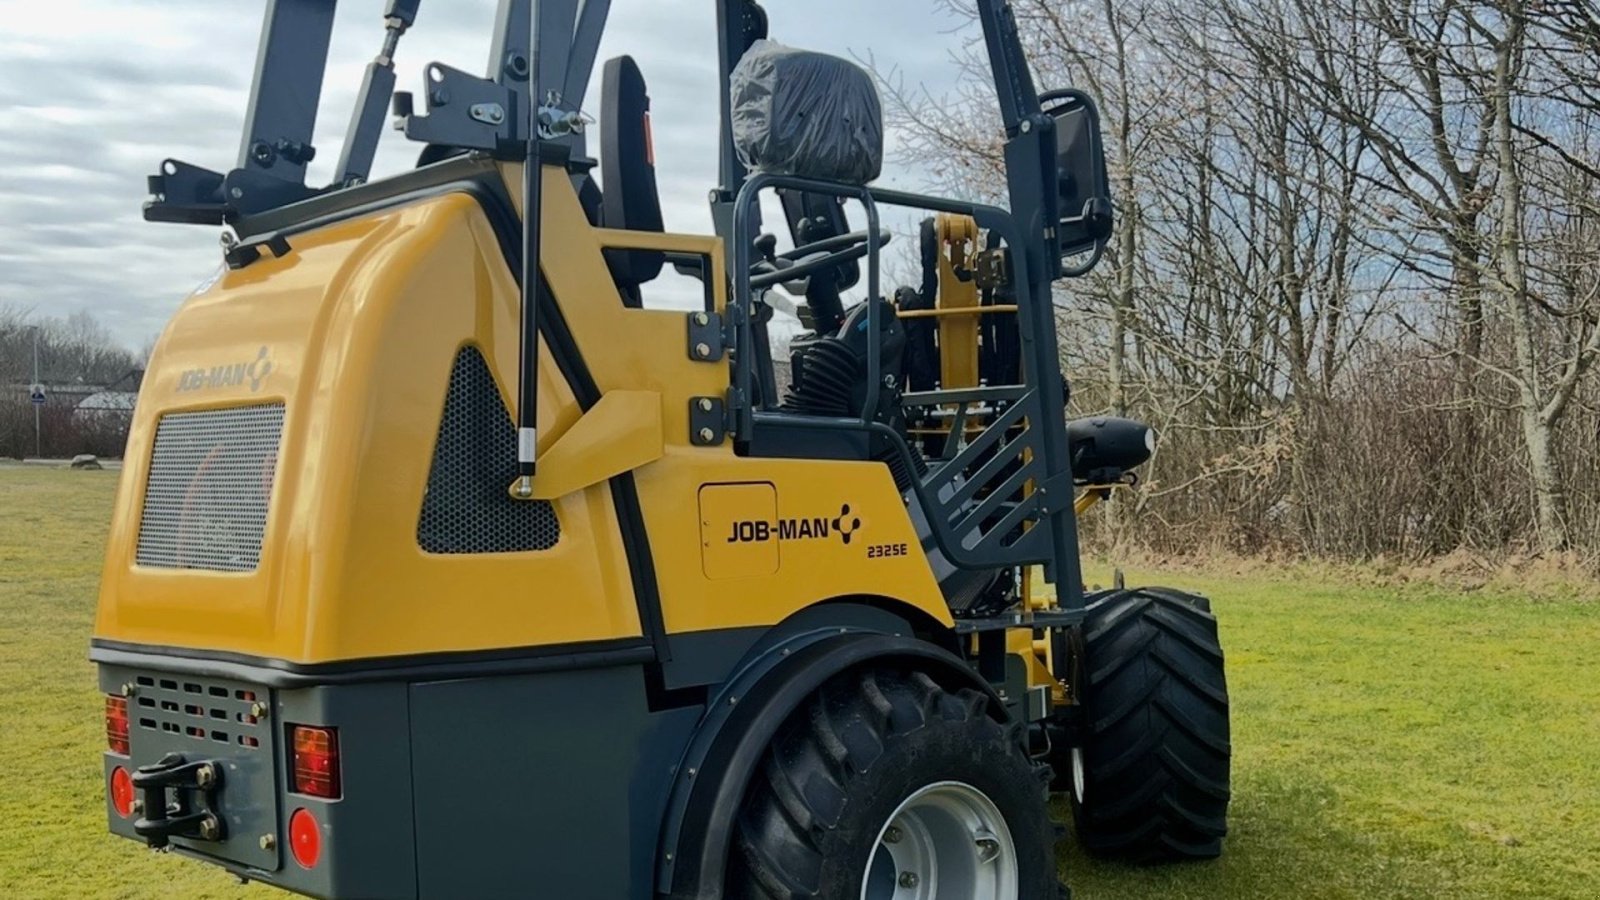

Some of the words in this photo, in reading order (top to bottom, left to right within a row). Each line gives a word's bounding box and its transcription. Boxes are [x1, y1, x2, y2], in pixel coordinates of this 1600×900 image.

[176, 362, 247, 392] JOB-MAN
[727, 518, 828, 542] JOB-MAN
[867, 543, 907, 558] 2325E
